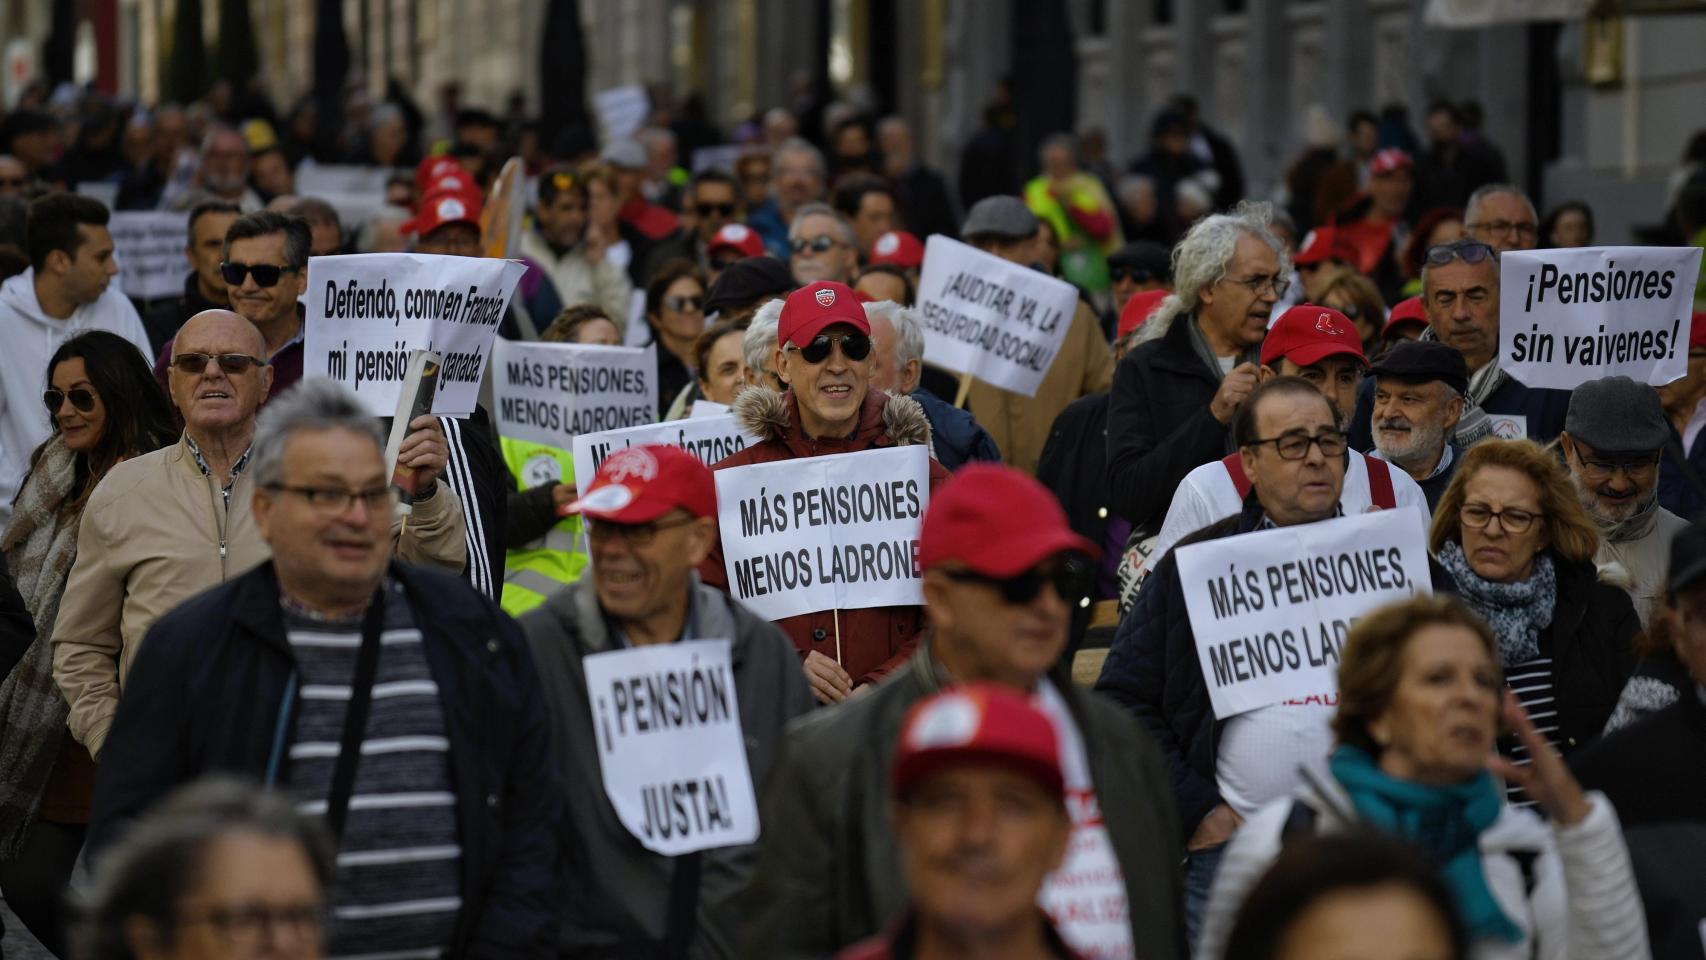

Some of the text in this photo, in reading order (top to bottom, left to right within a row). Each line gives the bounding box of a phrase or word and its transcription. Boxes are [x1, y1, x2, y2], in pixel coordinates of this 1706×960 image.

[324, 279, 504, 333] Defiendo, como en Francia,
[941, 272, 1063, 335] ¡AUDITAR, YA, LA
[1524, 261, 1676, 312] ¡Pensiones
[923, 300, 999, 351] SEGURIDAD
[1511, 319, 1681, 366] sin vaivenes!
[328, 340, 481, 392] mi pensió ganada.
[507, 357, 648, 397] MÁS PENSIONES,
[501, 397, 652, 436] MENOS LADRONES
[739, 479, 924, 538] MÁS PENSIONES,
[734, 539, 923, 600] MENOS LADRONE
[1207, 547, 1414, 620] MÁS PENSIONES,
[1208, 629, 1301, 688] MENOS
[641, 774, 733, 840] JUSTA!
